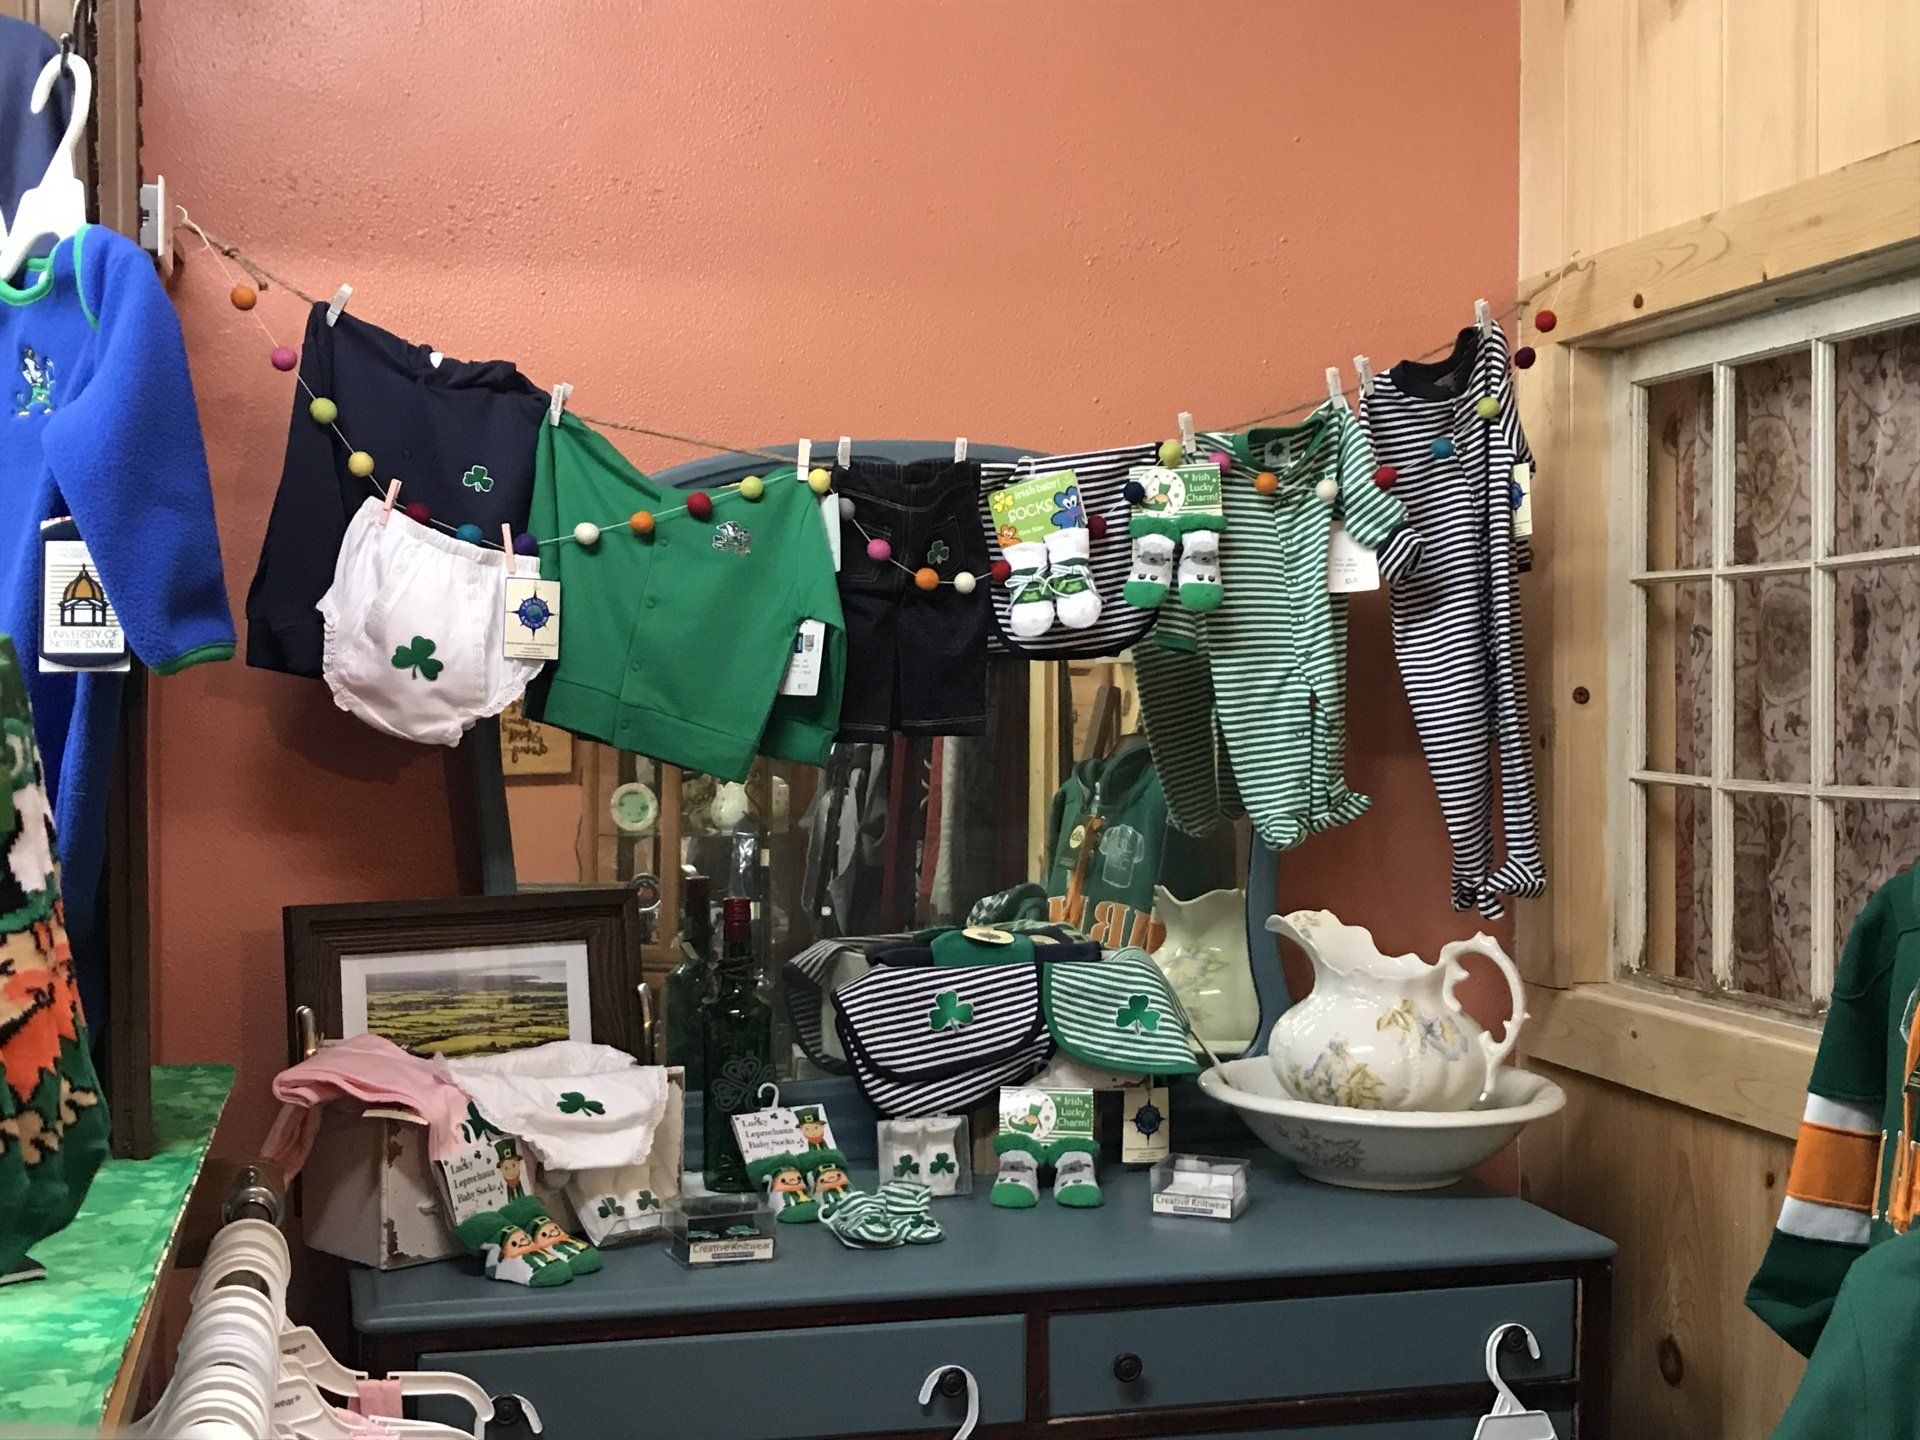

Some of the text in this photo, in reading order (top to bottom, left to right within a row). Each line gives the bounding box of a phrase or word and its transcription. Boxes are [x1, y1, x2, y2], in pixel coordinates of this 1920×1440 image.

[1191, 473, 1210, 481] Irish
[1189, 483, 1214, 493] Lucky
[1186, 493, 1218, 502] Charm!
[1008, 498, 1053, 523] SOCKS
[104, 629, 119, 639] OF
[1064, 1097, 1083, 1106] Irish
[1061, 1108, 1086, 1117] Lucky
[742, 1119, 768, 1128] Lucky
[1057, 1118, 1089, 1127] Charm!
[450, 1161, 473, 1175] Lucky
[693, 1243, 730, 1253] Creative
